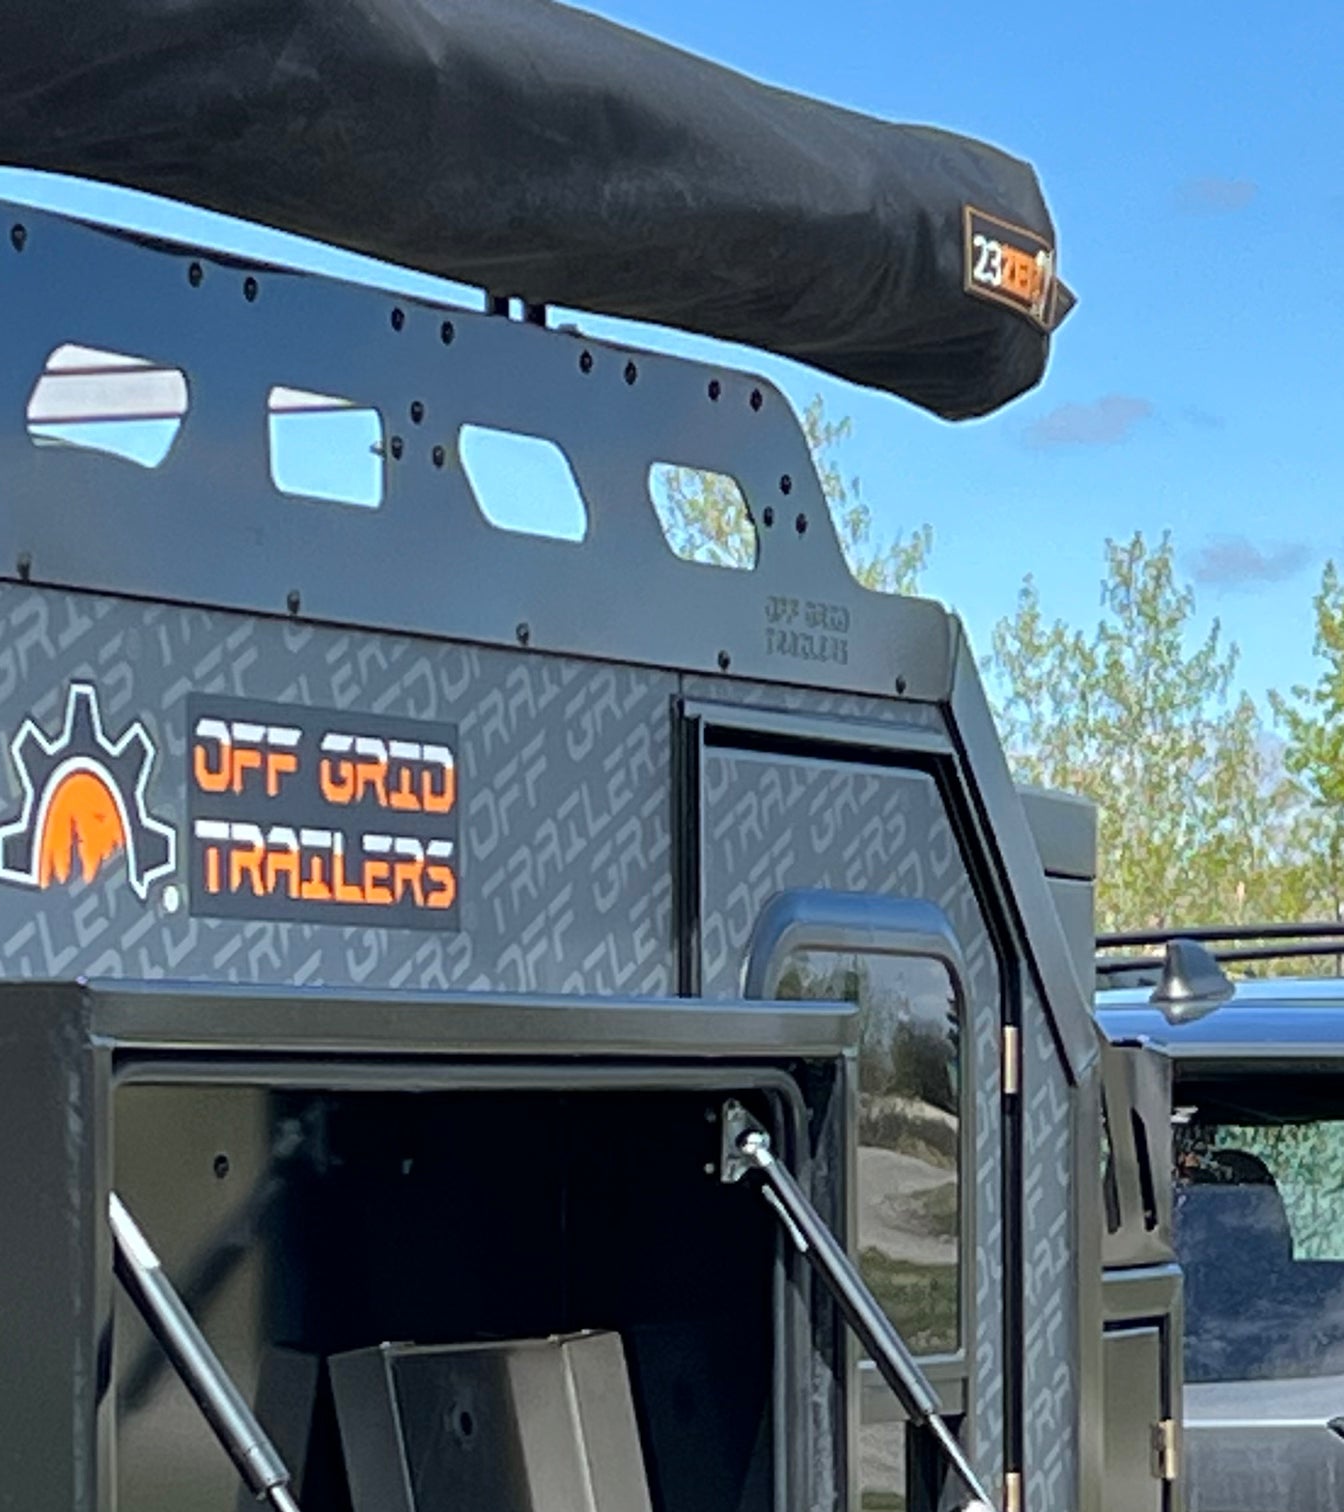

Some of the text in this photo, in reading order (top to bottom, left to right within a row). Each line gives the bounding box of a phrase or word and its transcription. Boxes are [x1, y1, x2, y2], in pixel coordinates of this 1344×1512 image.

[194, 719, 456, 814] OFF GRID
[195, 820, 456, 909] TRAILERS
